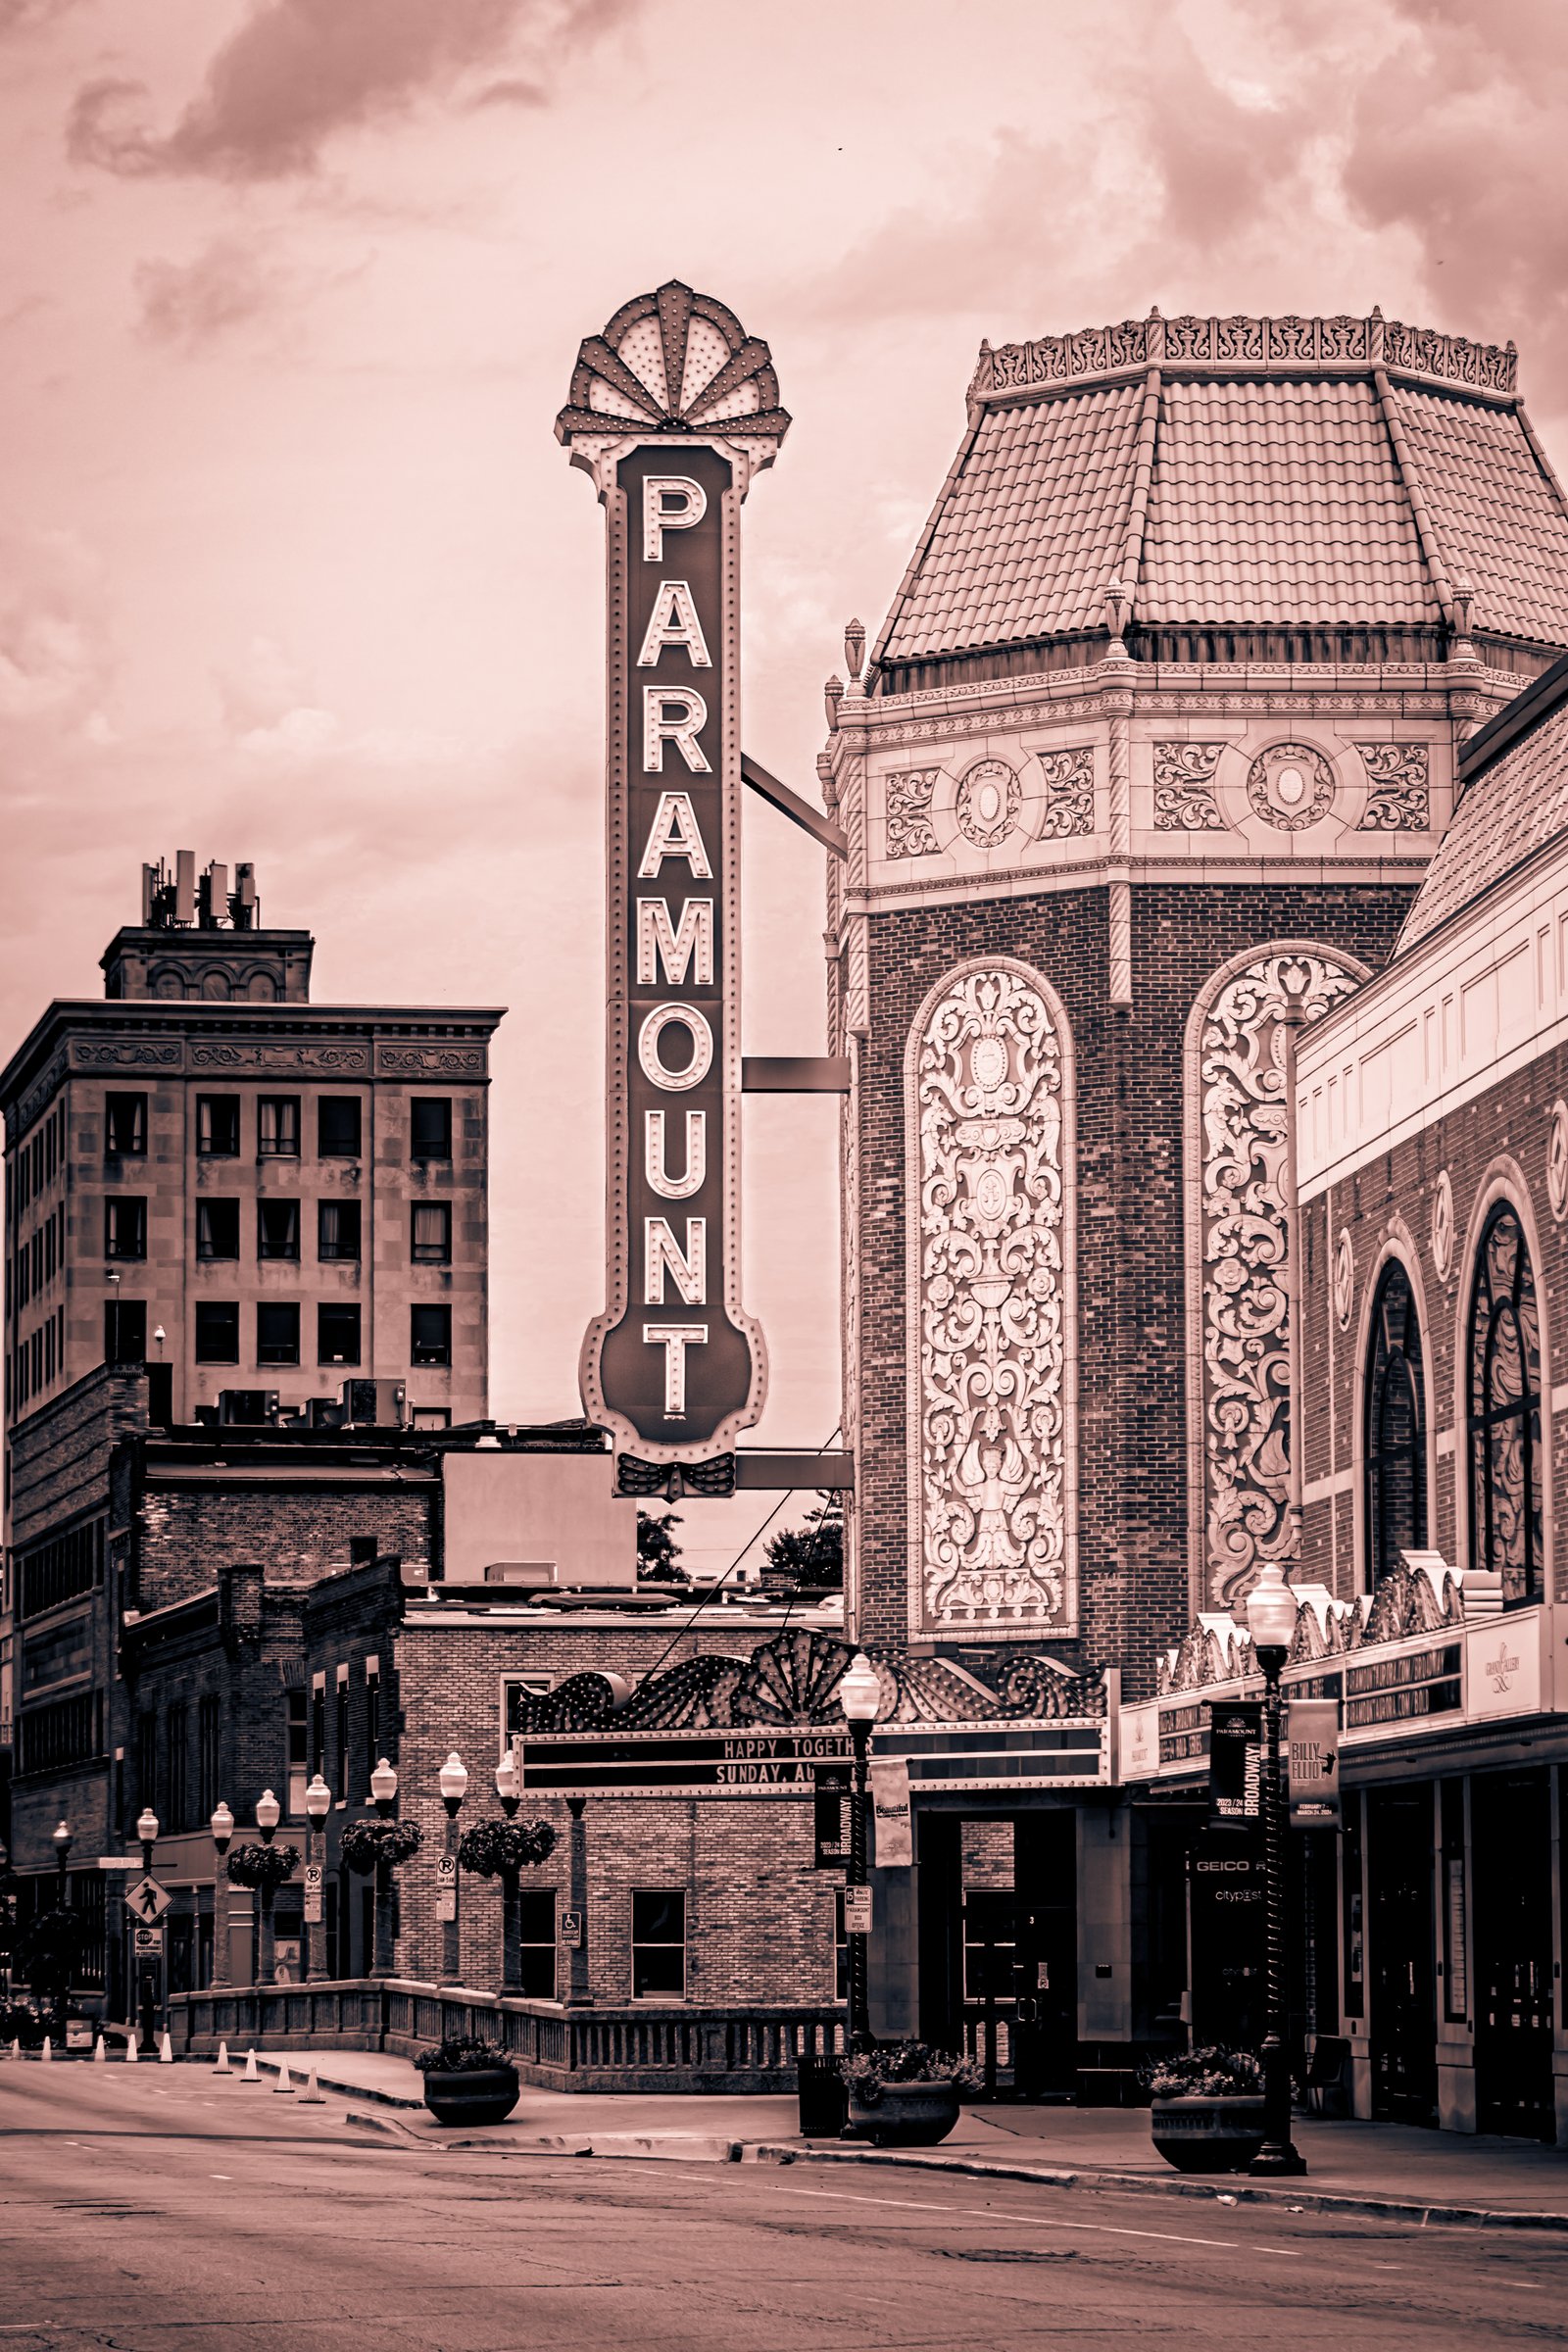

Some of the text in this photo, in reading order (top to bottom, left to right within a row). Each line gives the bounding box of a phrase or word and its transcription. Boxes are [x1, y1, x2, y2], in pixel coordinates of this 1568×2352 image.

[636, 475, 713, 1413] PARAMOUNT
[724, 1737, 874, 1758] HAPPY TOGETHR
[1292, 1742, 1320, 1761] BILLY
[716, 1764, 787, 1783] SUNDAY,
[1292, 1761, 1327, 1780] ELLIOT
[1244, 1746, 1261, 1816] BROADWAY
[1219, 1806, 1244, 1816] SEASON
[840, 1799, 852, 1855] BROADWAY
[1197, 1861, 1250, 1872] GEICO
[846, 1891, 854, 1901] 15
[1029, 1916, 1035, 1925] 3
